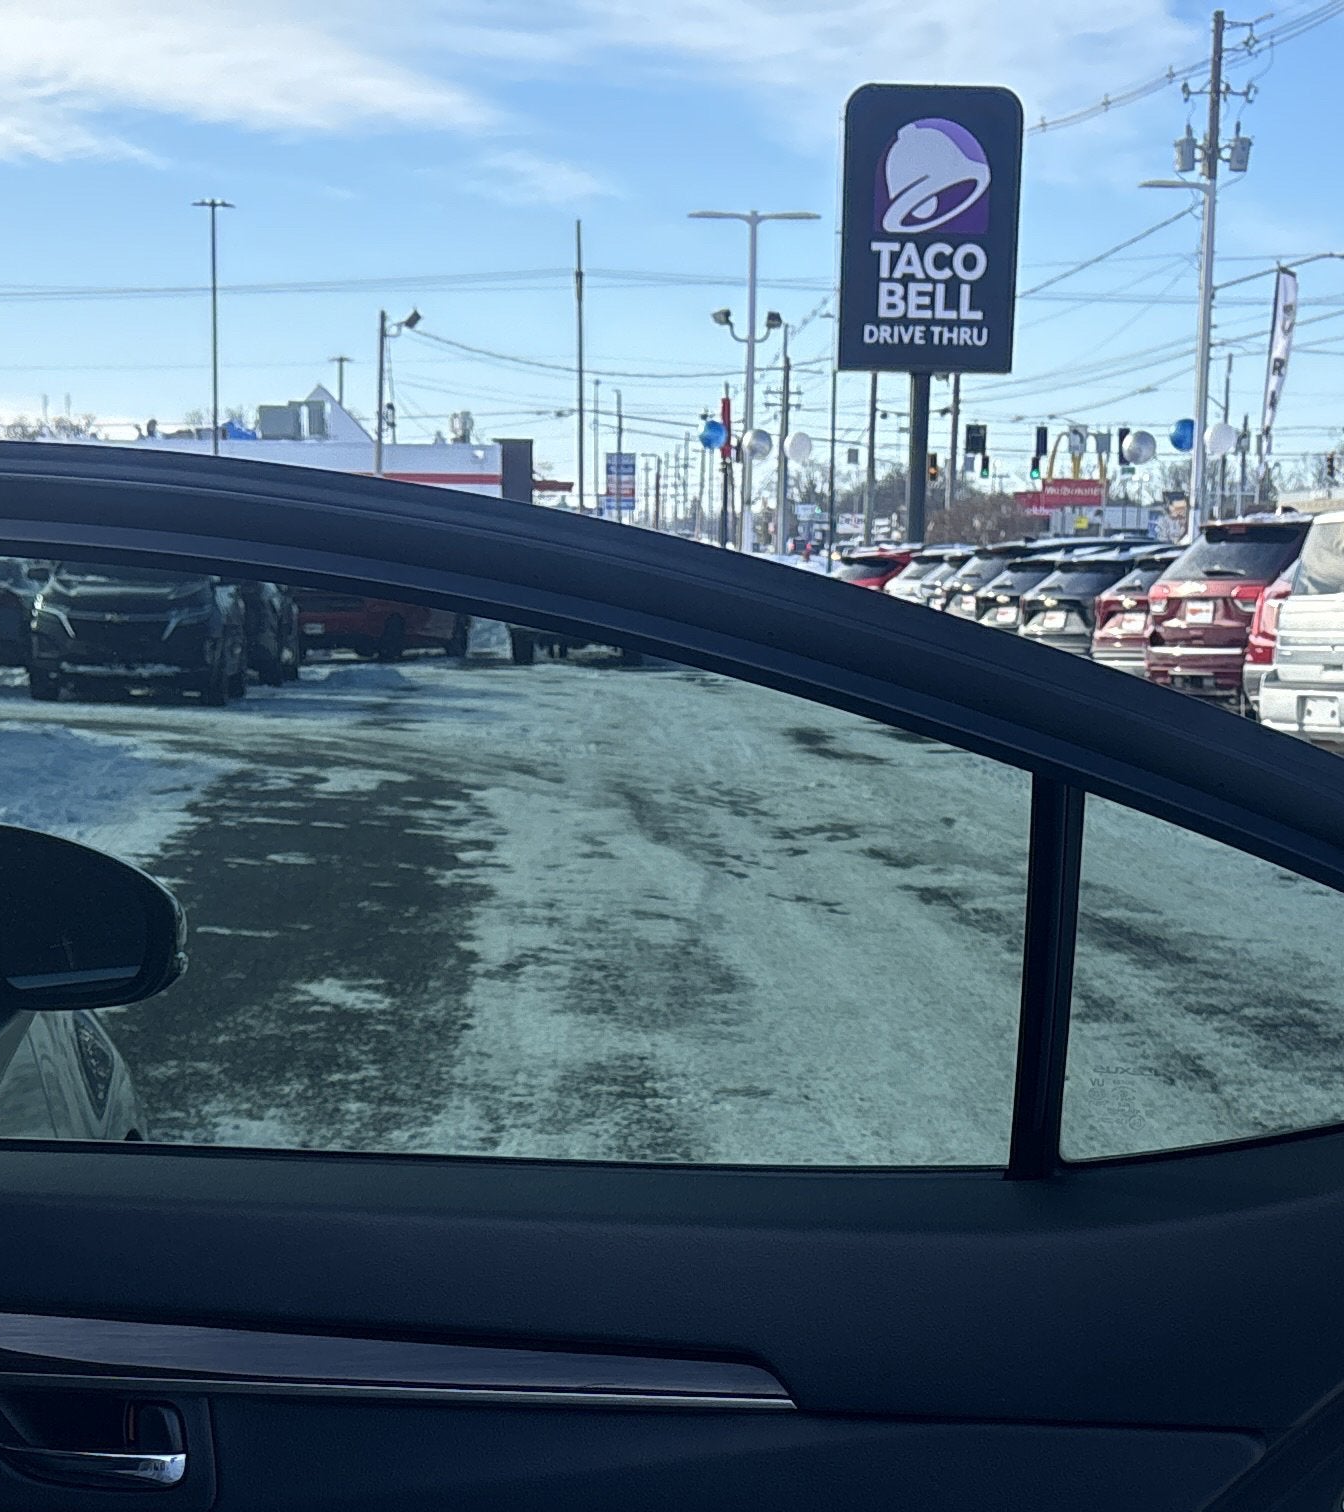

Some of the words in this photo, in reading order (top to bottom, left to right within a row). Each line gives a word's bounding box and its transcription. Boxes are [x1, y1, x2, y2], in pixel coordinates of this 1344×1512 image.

[870, 241, 988, 281] TACO
[877, 281, 984, 320] BELL
[863, 324, 926, 345] DRIVE
[930, 326, 988, 346] THRU
